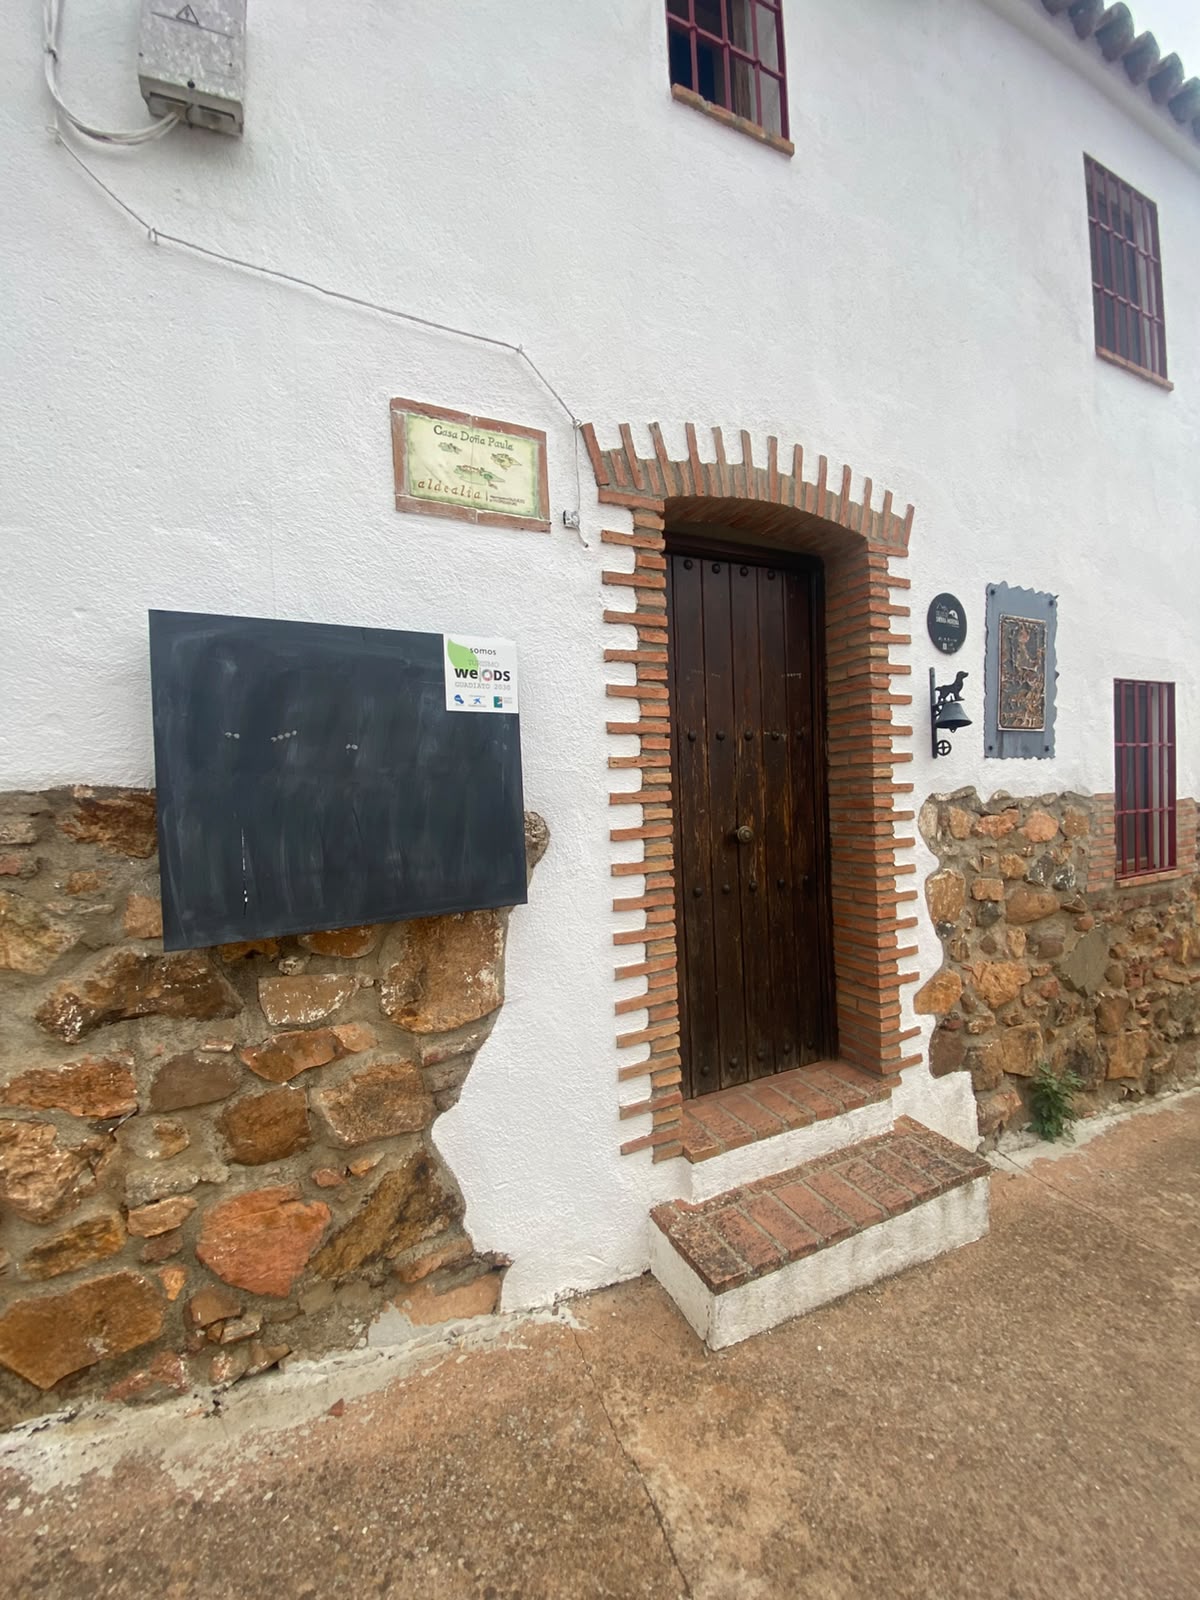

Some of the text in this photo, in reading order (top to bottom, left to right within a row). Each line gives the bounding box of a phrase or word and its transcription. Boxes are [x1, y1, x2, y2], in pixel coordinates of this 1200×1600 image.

[433, 424, 514, 451] Casa Doña Paula
[417, 478, 482, 500] aldealia
